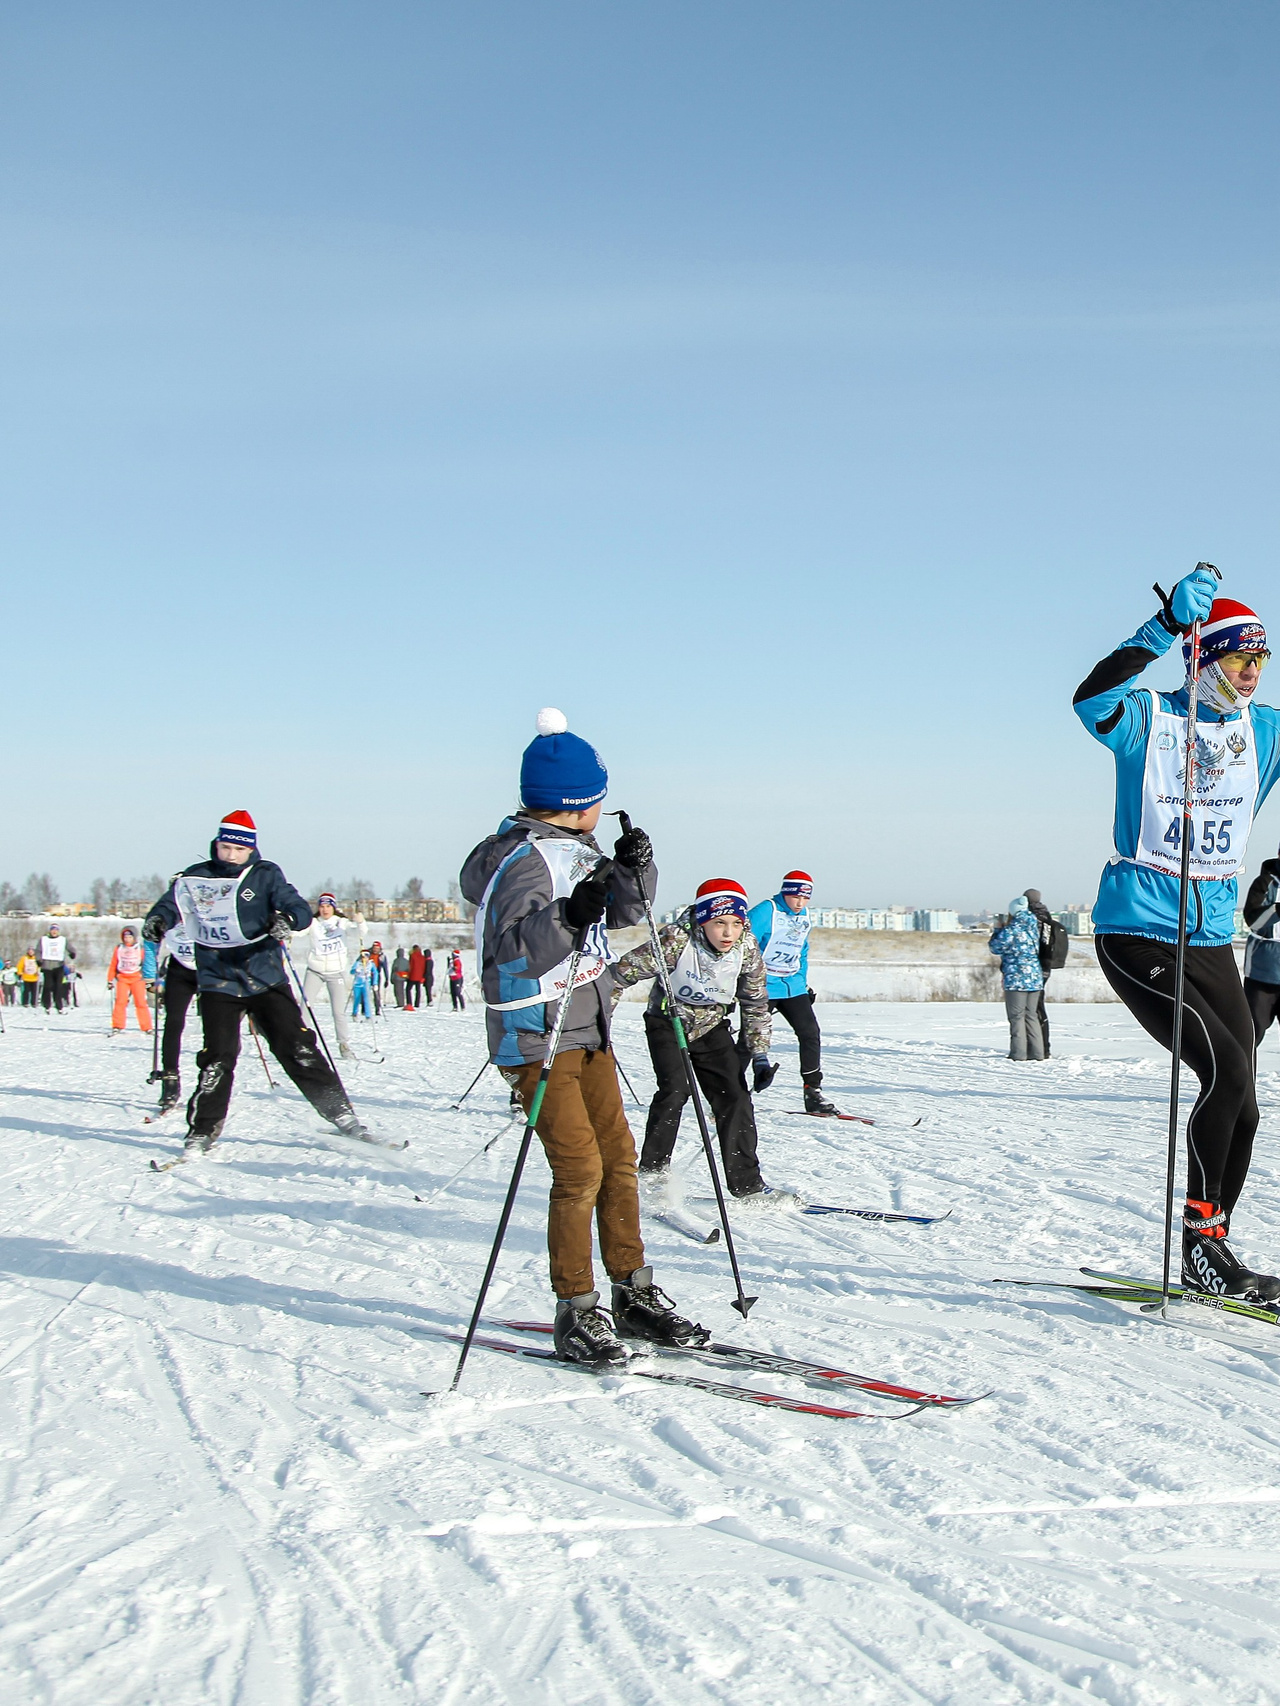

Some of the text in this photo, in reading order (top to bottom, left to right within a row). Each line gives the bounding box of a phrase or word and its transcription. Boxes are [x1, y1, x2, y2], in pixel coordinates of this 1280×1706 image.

[1205, 768, 1225, 776] 2018
[1151, 849, 1238, 866] Нижегодская область
[710, 908, 735, 919] 2018
[1181, 1293, 1225, 1311] FISCHER
